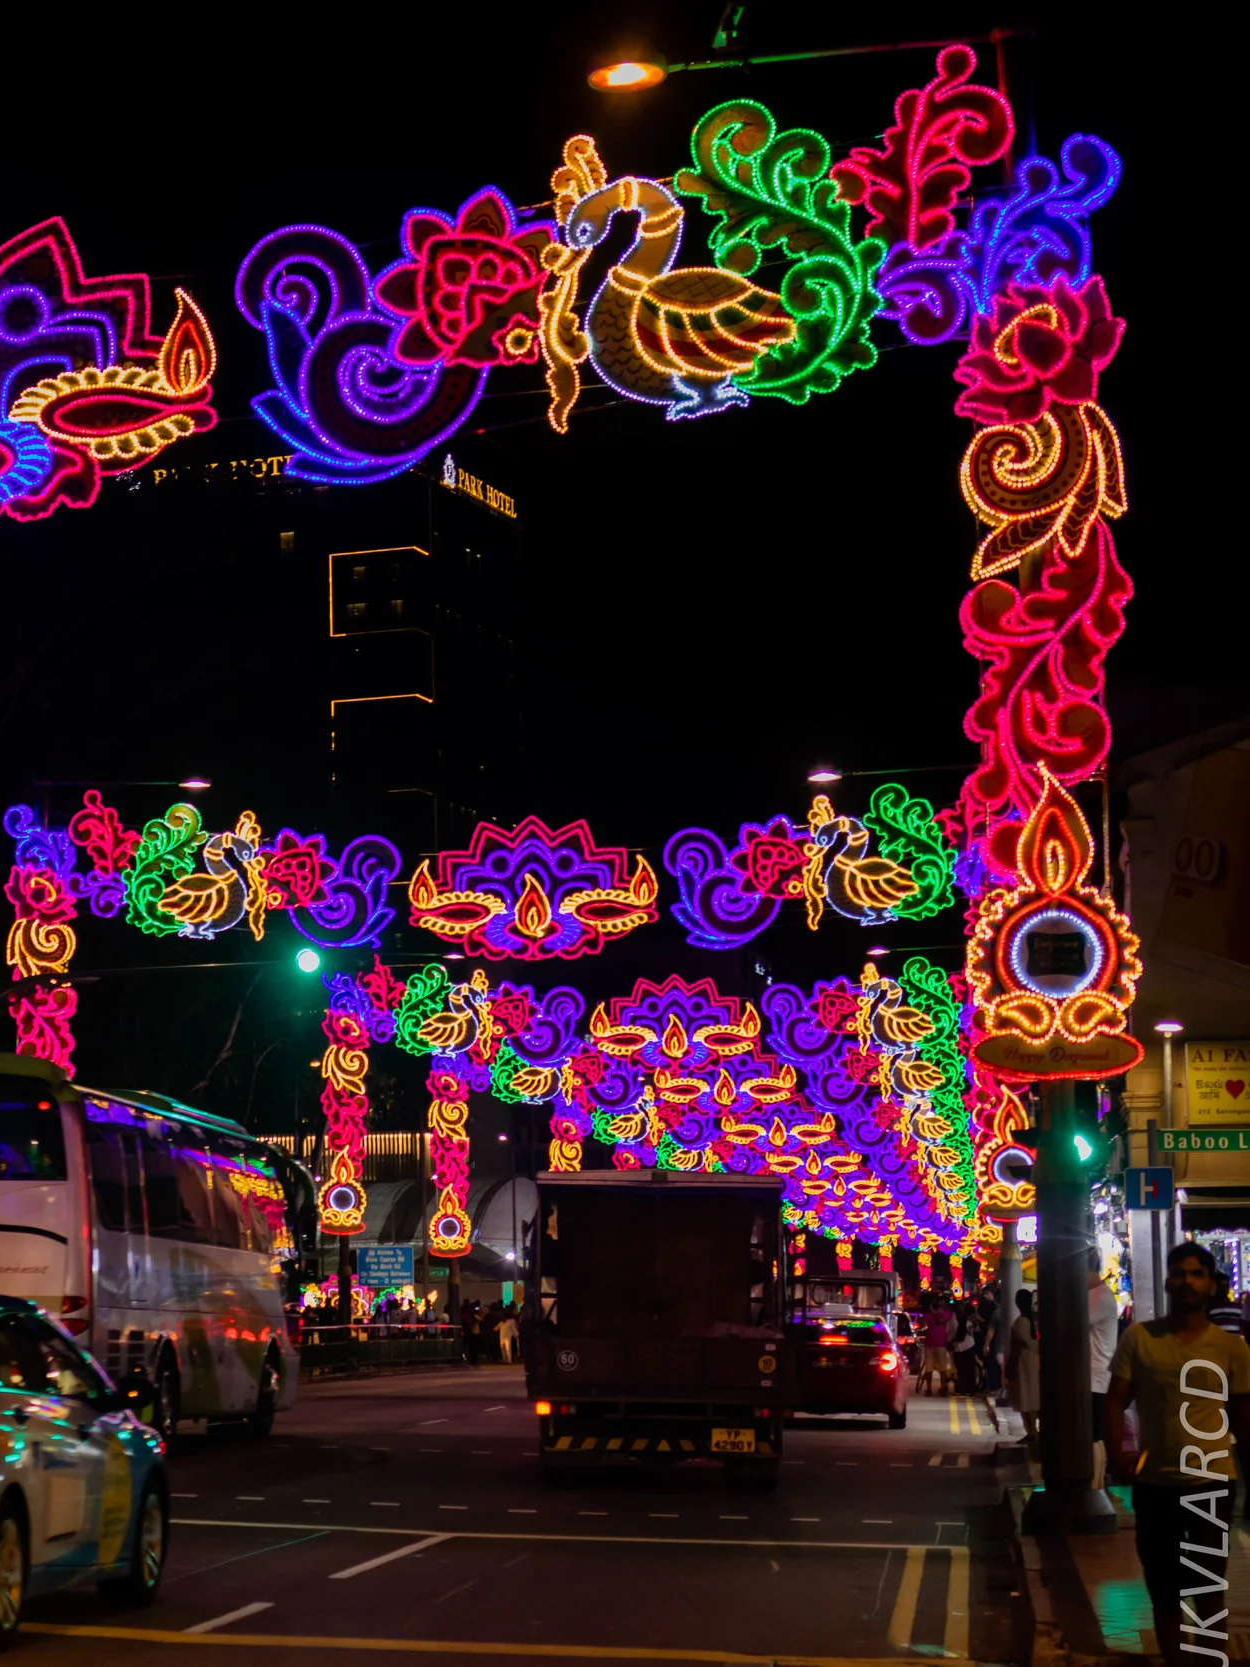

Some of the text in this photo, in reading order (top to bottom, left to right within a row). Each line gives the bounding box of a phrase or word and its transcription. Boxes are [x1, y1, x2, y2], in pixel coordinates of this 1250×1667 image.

[457, 467, 518, 520] PARK HOTEL
[1162, 1132, 1230, 1150] Baboo
[560, 1353, 575, 1365] 60
